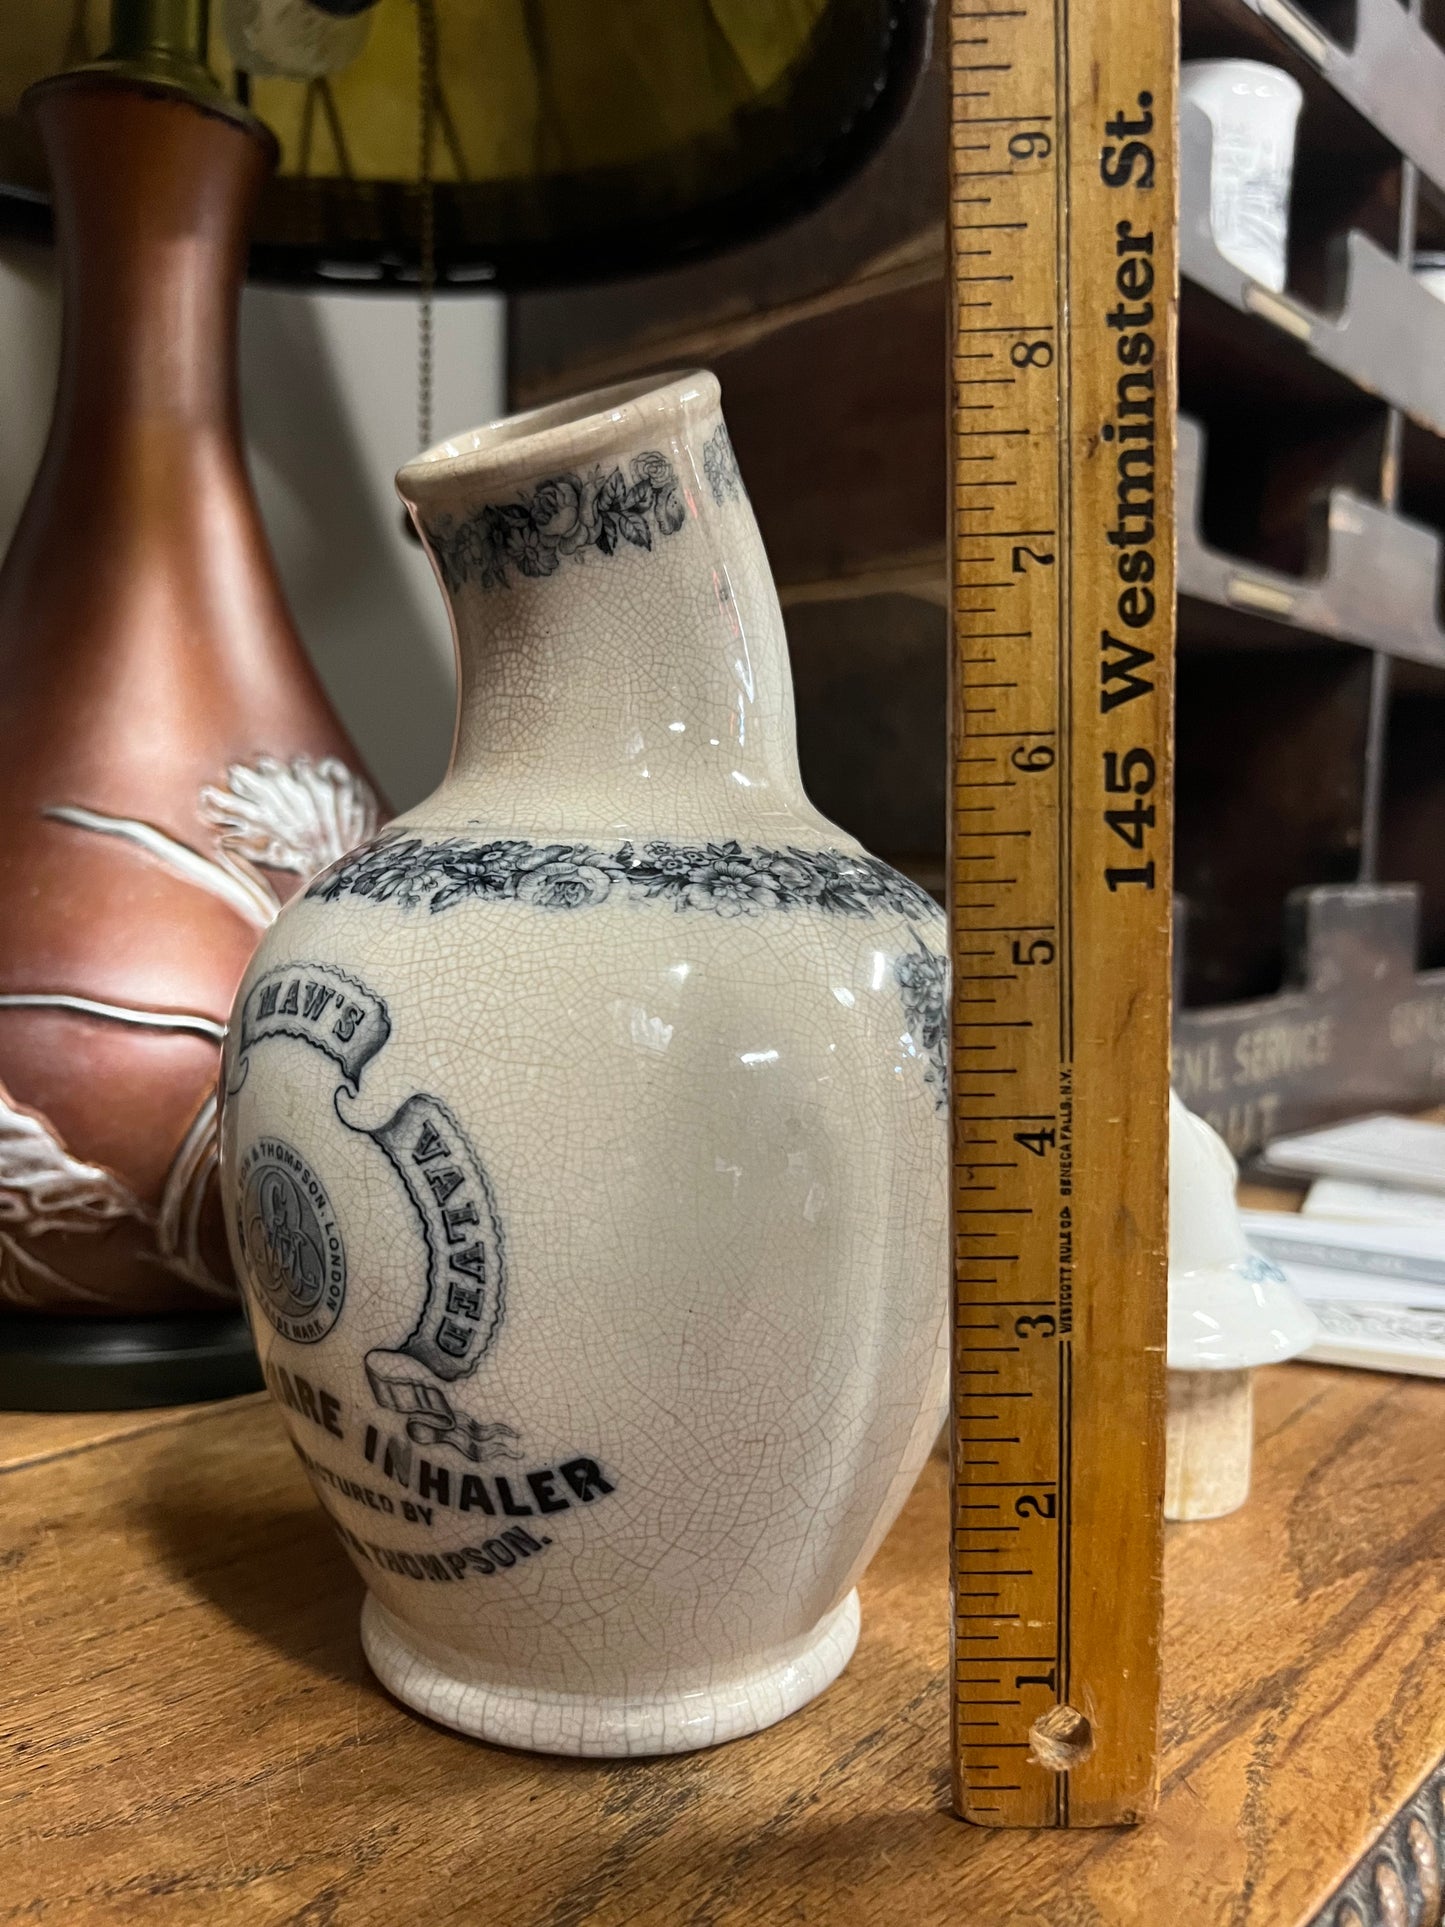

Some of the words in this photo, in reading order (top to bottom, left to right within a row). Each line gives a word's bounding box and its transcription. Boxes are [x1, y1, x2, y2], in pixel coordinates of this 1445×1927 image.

[1008, 131, 1052, 161] 9
[1101, 90, 1156, 190] St.
[1010, 340, 1054, 369] 8
[1101, 219, 1156, 715] Westminster
[1012, 545, 1056, 574] 7
[1011, 745, 1055, 773] 6
[1103, 746, 1156, 893] 145
[1012, 938, 1056, 967] 5
[256, 978, 367, 1042] MAW'S
[1013, 1127, 1057, 1158] 4
[1060, 1143, 1073, 1197] SENECA
[411, 1119, 487, 1359] VALVED
[1060, 1231, 1073, 1263] RULE
[325, 1221, 342, 1312] LONDON
[1014, 1313, 1057, 1339] 3
[364, 1424, 616, 1517] INHALER
[402, 1501, 433, 1527] BY
[1015, 1493, 1056, 1519] 2
[1015, 1667, 1056, 1692] 1
